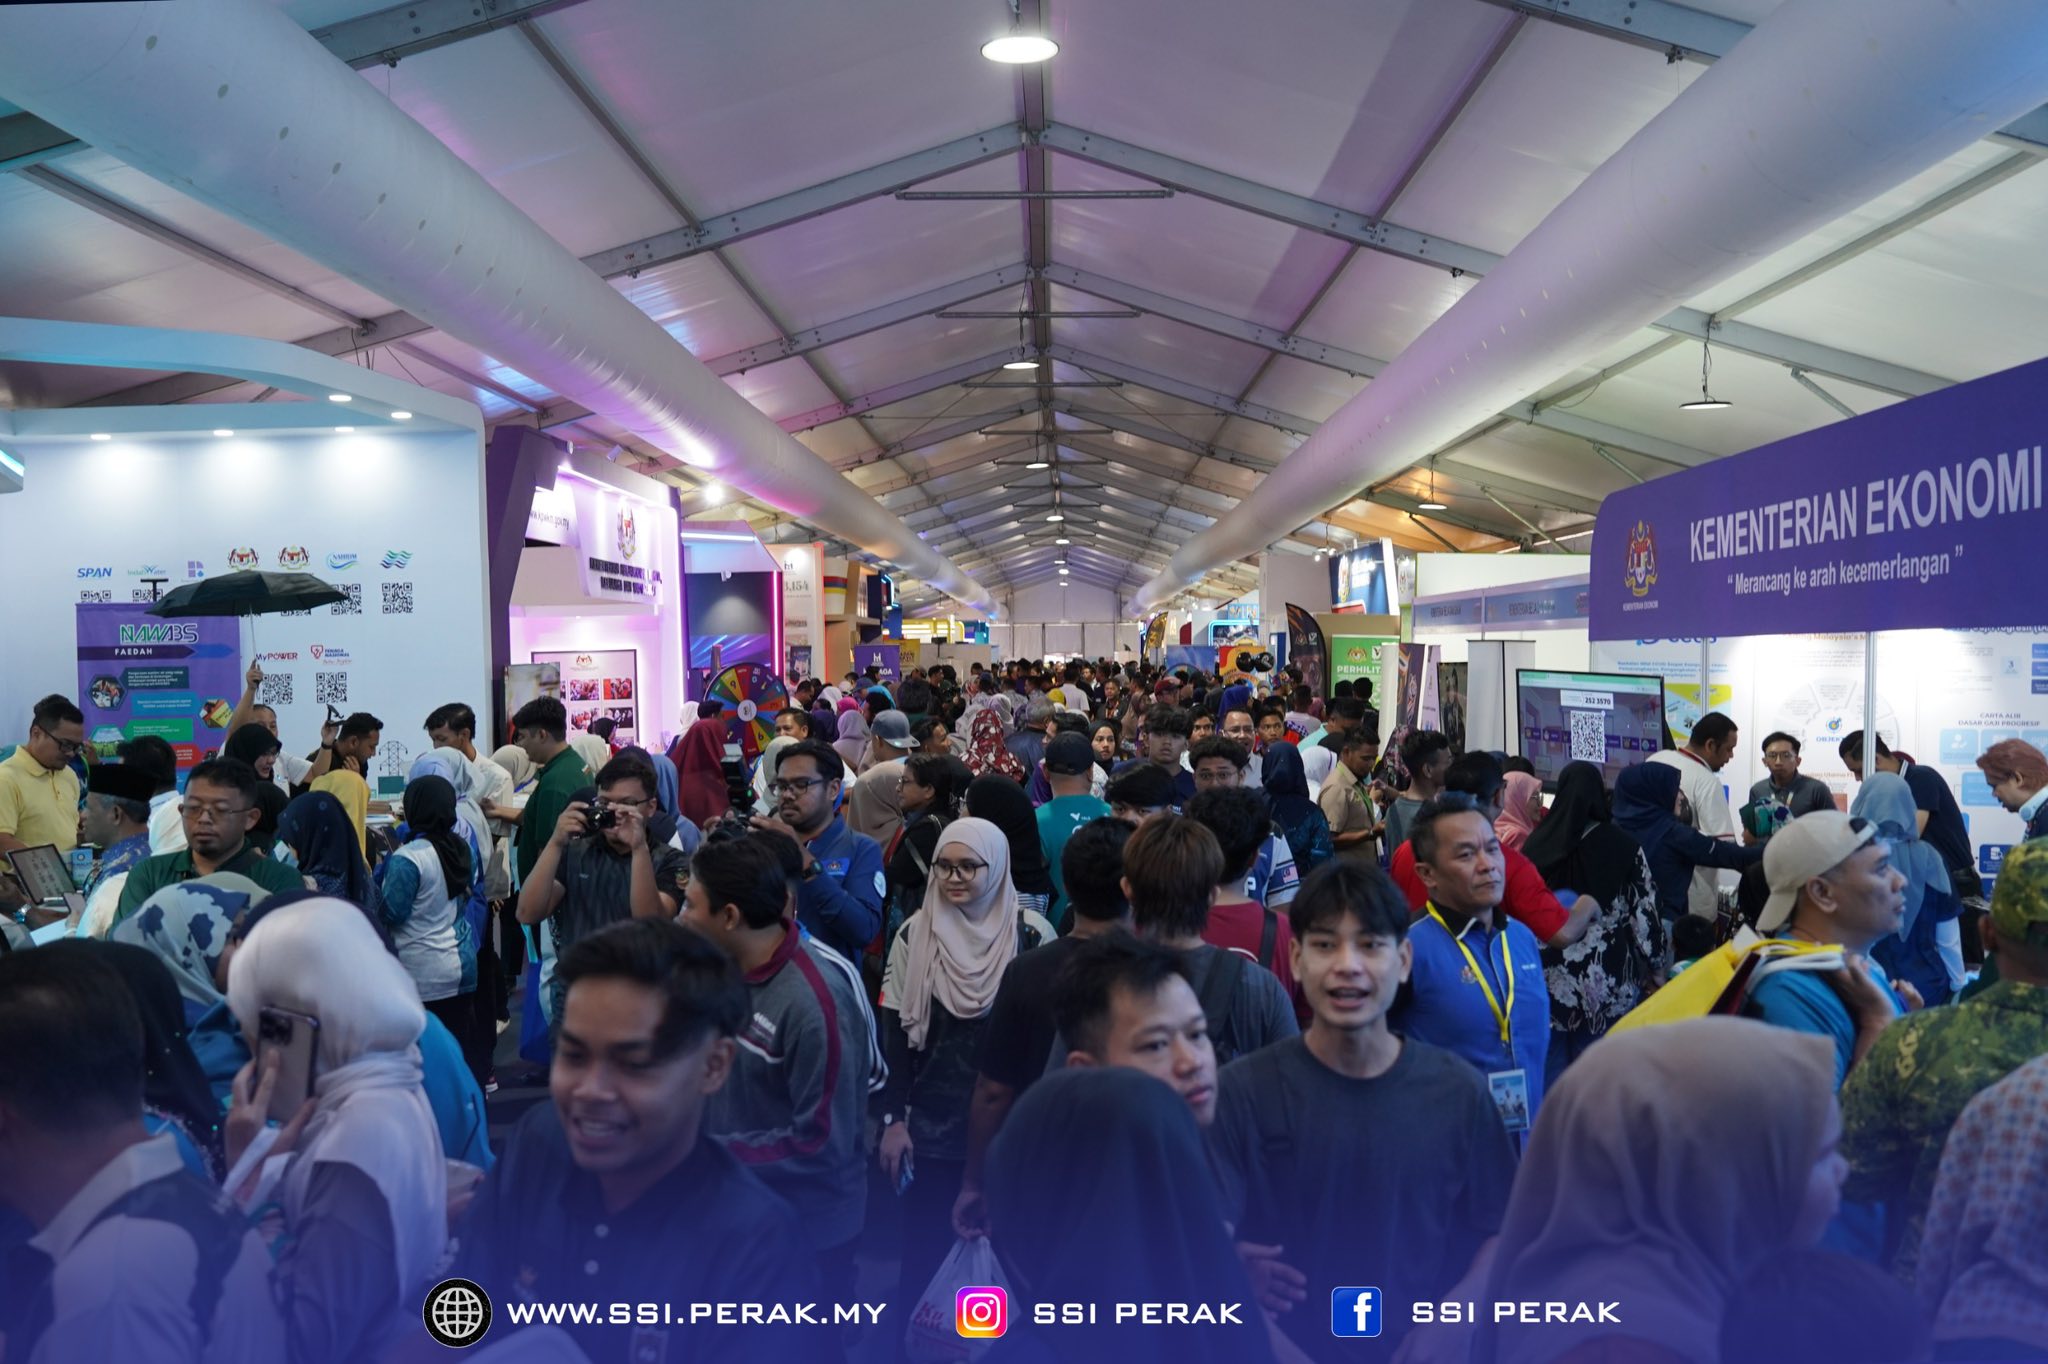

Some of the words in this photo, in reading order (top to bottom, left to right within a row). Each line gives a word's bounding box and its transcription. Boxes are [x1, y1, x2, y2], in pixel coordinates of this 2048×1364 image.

[1690, 486, 1857, 563] KEMENTERIAN
[1866, 445, 2042, 535] EKONOMI
[77, 567, 112, 578] SPAN
[1793, 565, 1807, 589] ke
[1809, 561, 1836, 587] arah
[120, 623, 199, 644] NAWABS
[114, 648, 153, 656] FAEDAH
[255, 652, 298, 662] MyPOWER
[1336, 665, 1382, 674] PERHILIT
